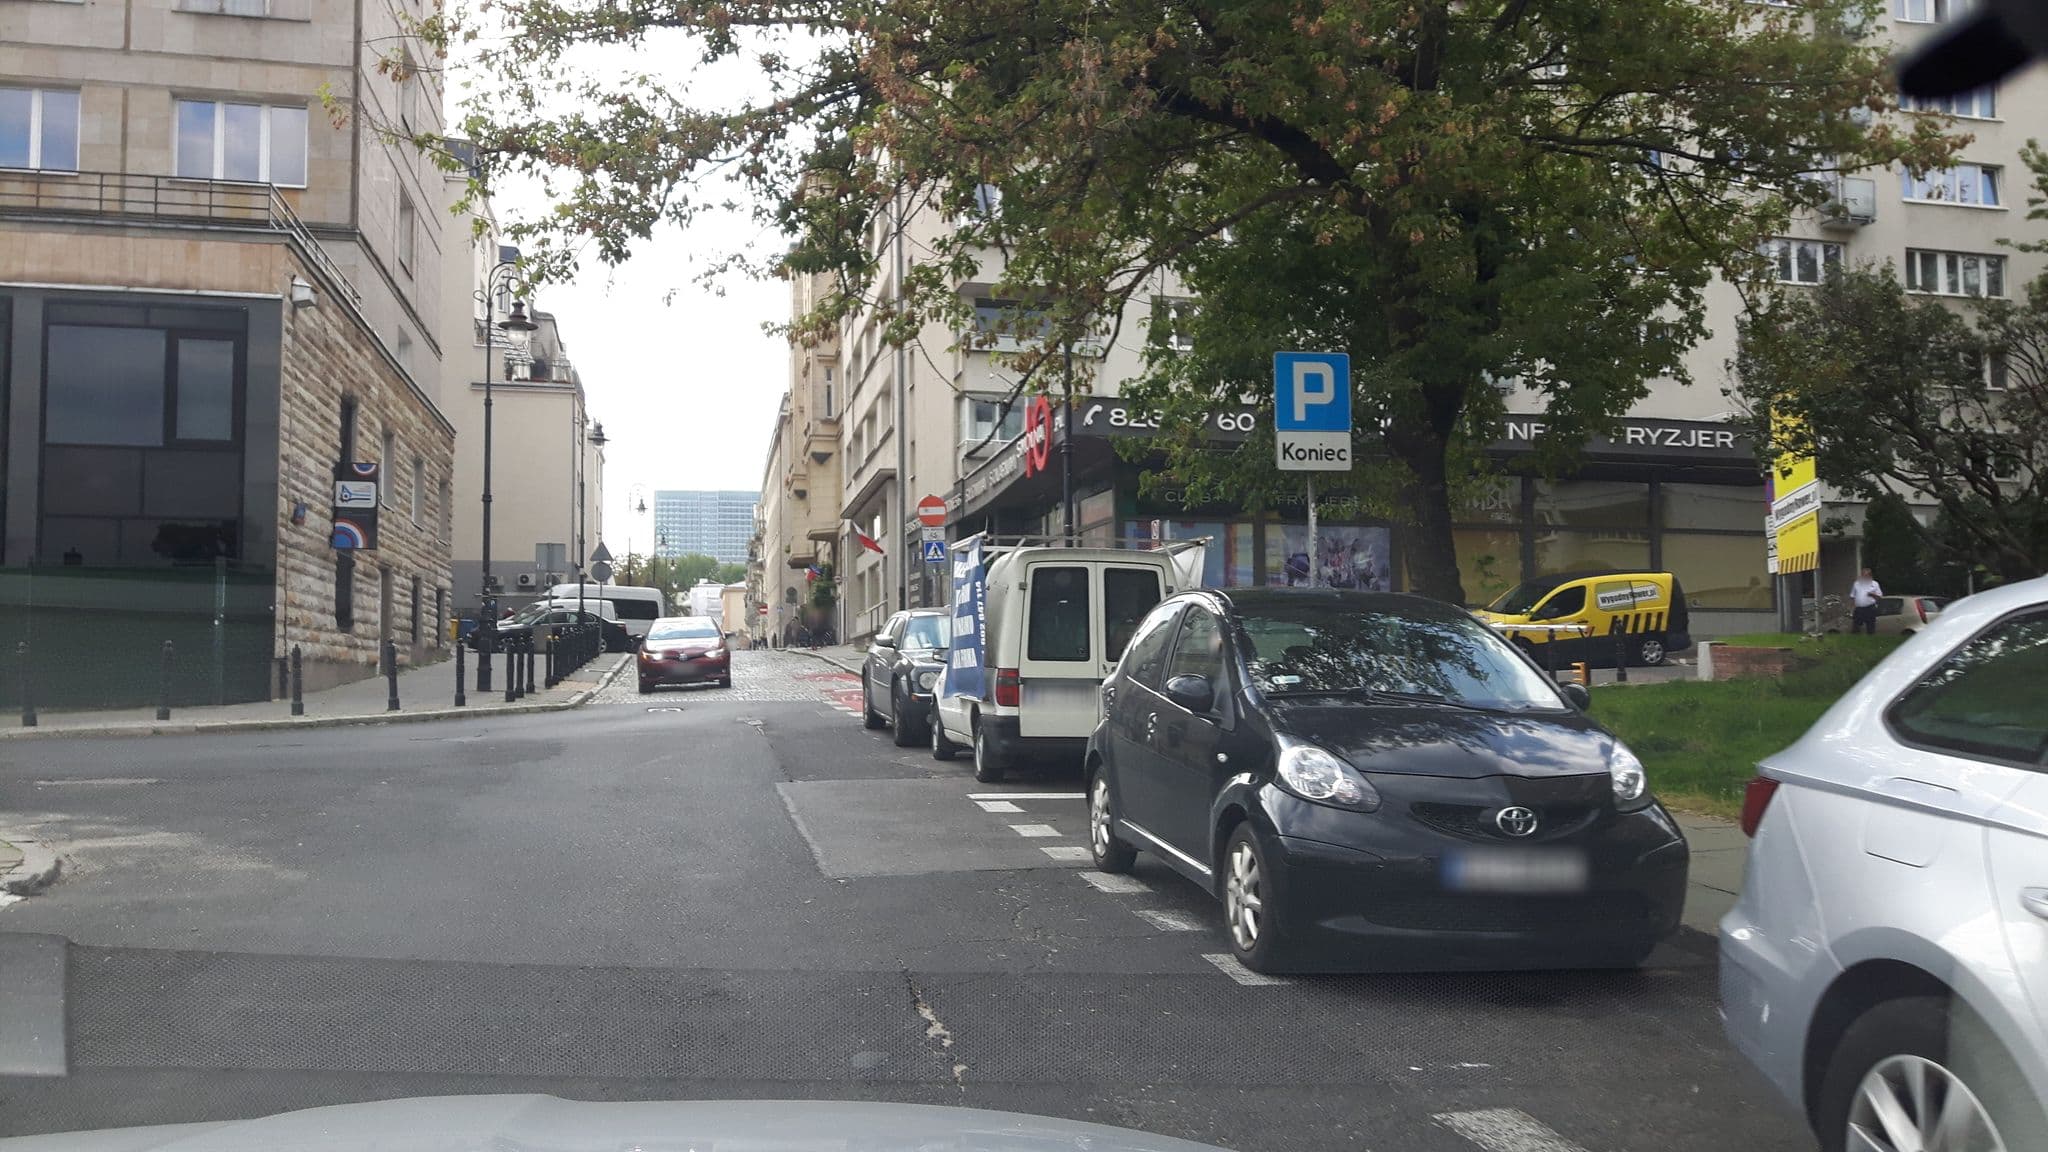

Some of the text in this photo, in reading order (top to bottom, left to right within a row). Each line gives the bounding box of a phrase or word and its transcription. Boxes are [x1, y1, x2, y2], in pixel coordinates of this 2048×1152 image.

[1293, 362, 1335, 422] P
[1610, 426, 1735, 448] RYZJER
[1282, 442, 1348, 462] Koniec
